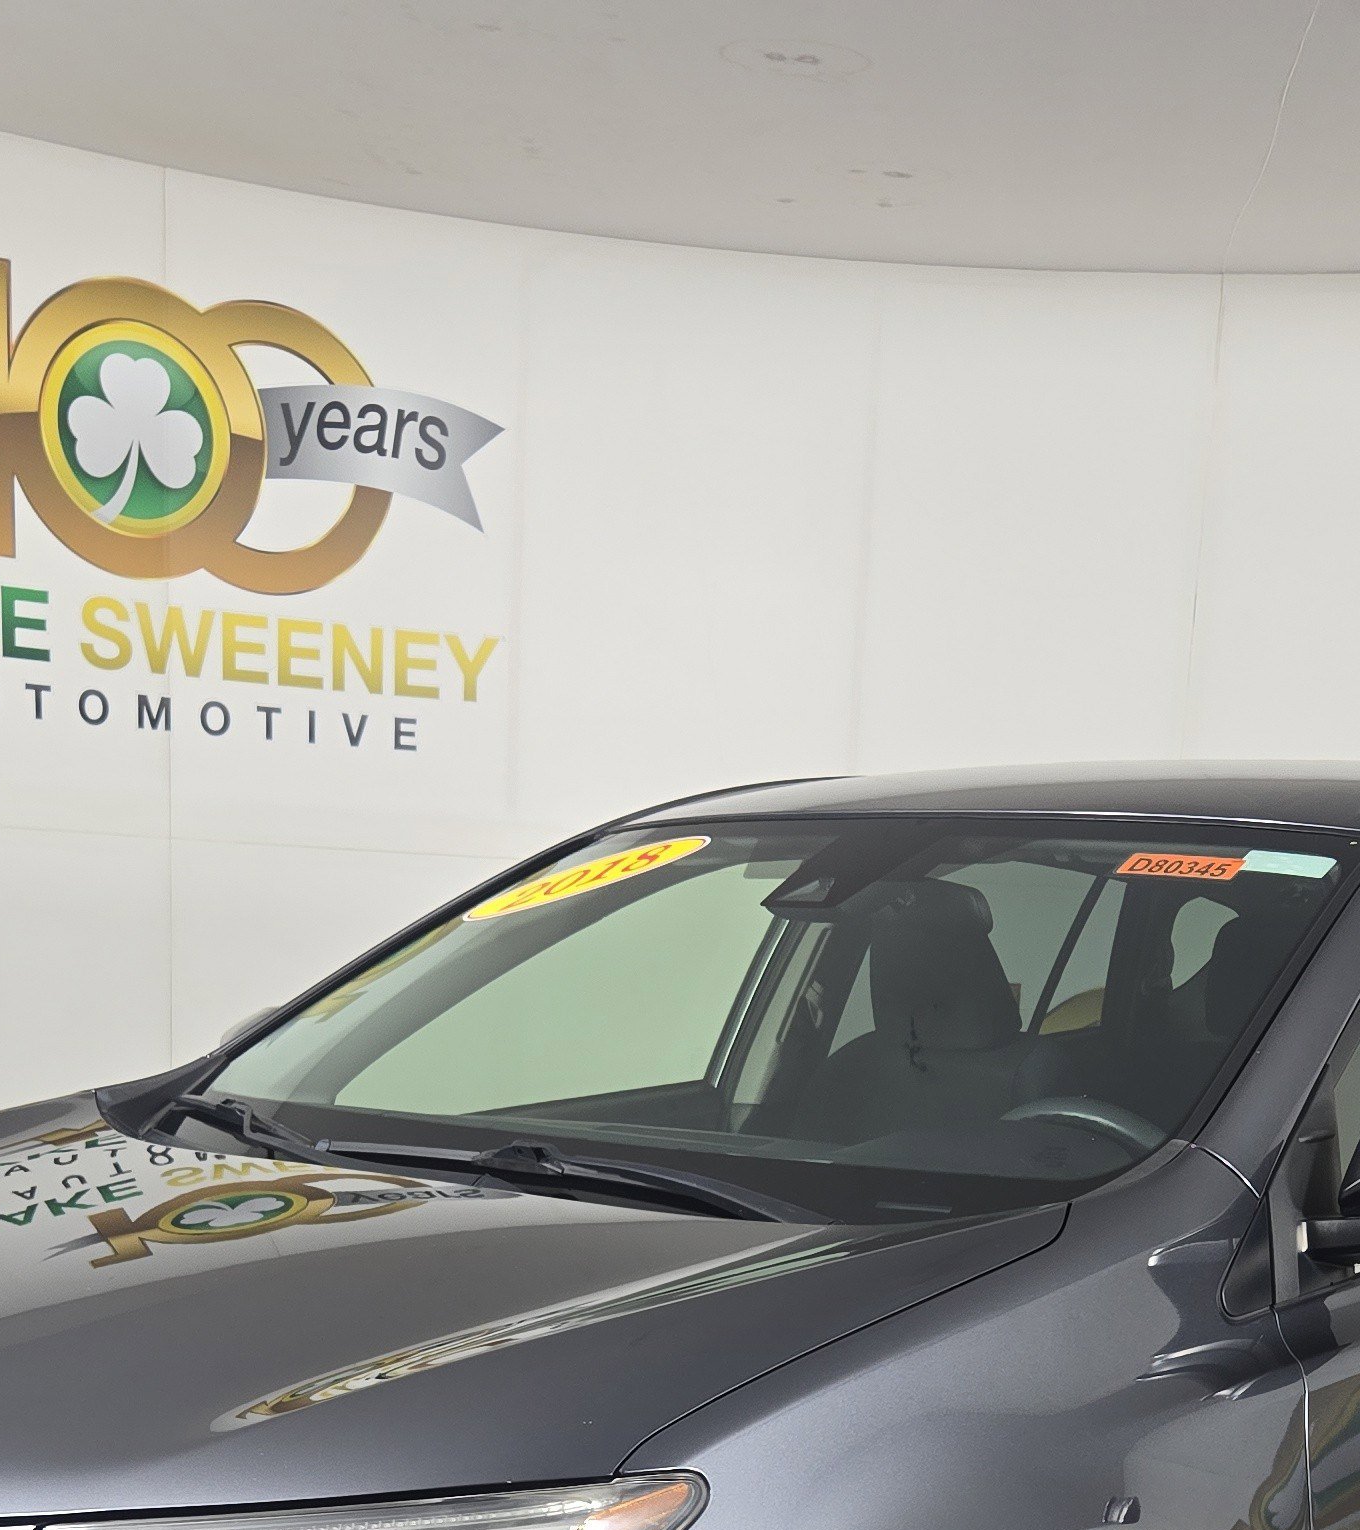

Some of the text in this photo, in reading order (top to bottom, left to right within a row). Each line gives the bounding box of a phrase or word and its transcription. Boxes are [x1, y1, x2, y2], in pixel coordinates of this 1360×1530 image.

[278, 400, 449, 471] years
[79, 596, 499, 703] SWEENEY
[499, 844, 672, 912] 2018
[1127, 857, 1232, 877] D80345
